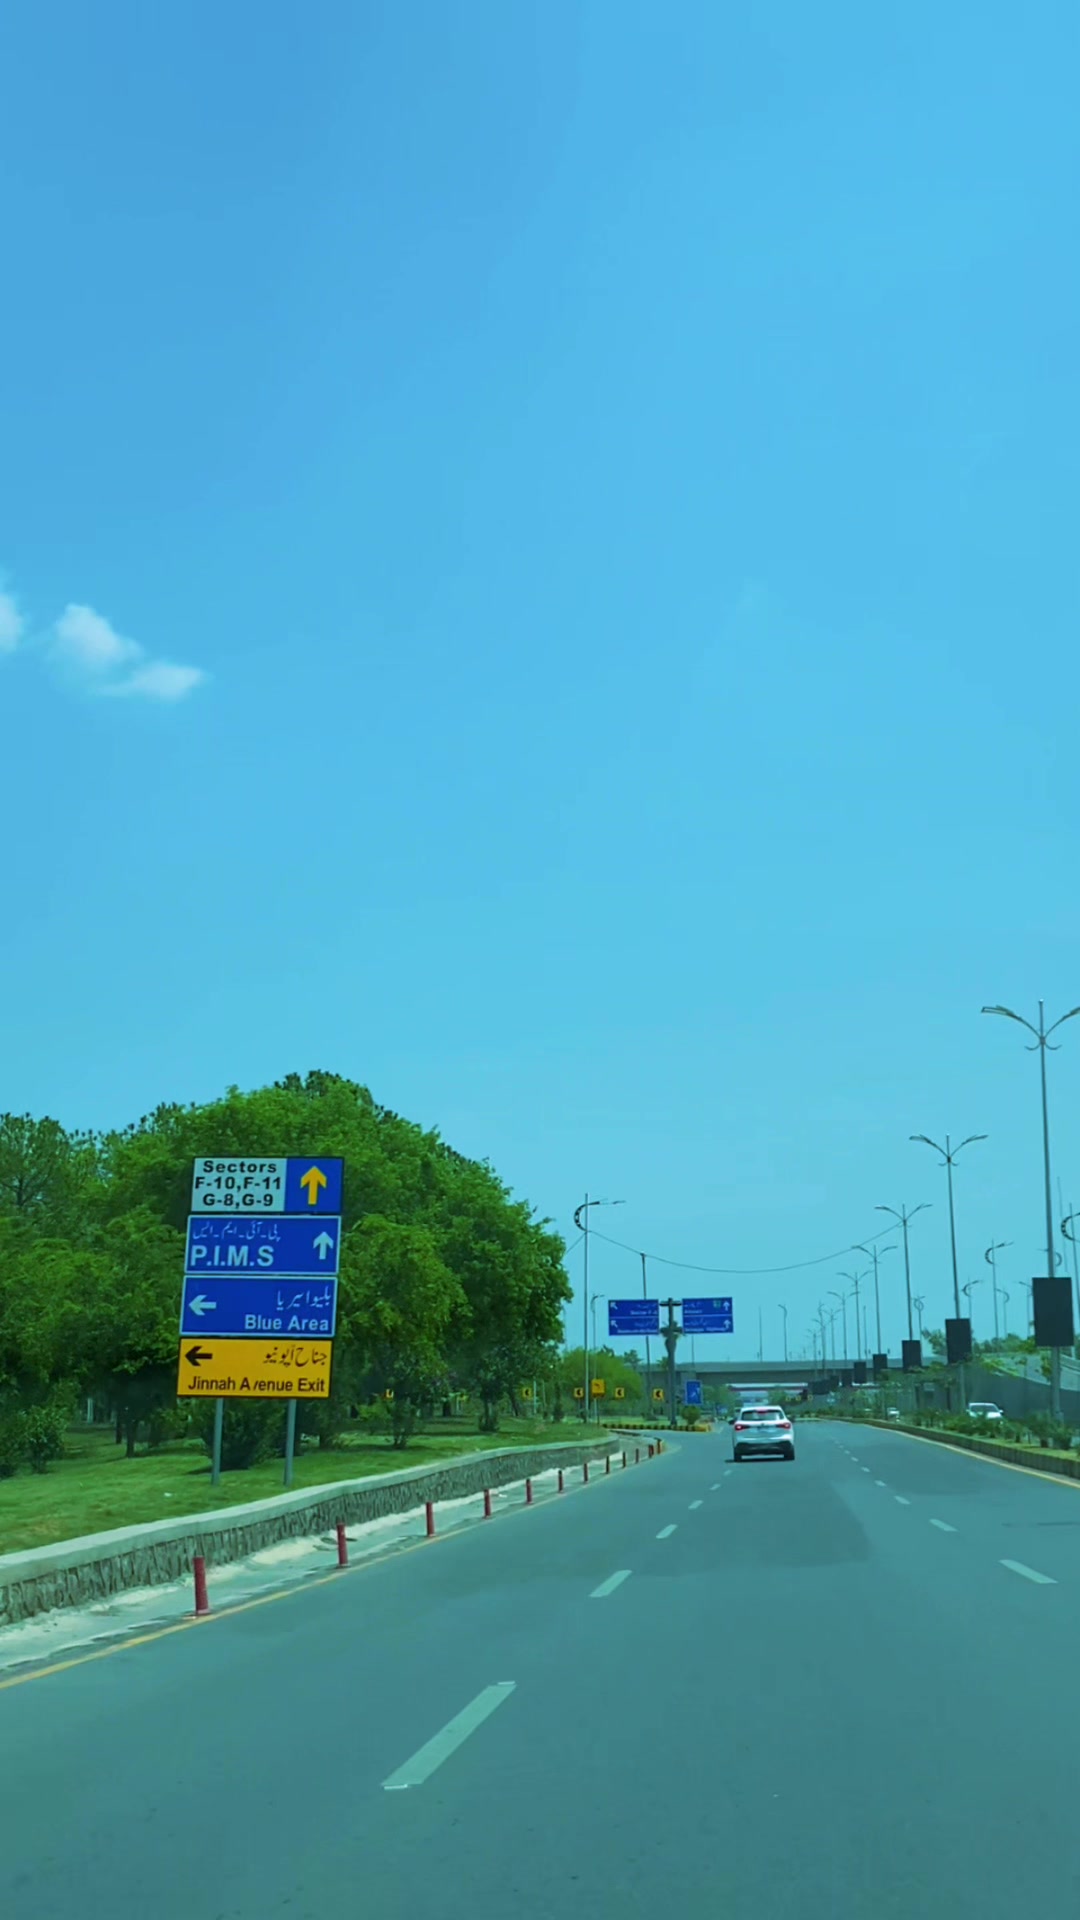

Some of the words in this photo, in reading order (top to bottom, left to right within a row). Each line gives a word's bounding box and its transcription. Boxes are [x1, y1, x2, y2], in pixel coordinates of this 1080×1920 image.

[203, 1160, 277, 1173] Sectors
[190, 1245, 274, 1267] P.I.M.S
[244, 1314, 282, 1330] Blue
[287, 1315, 329, 1331] Area
[188, 1376, 236, 1391] Jinnah
[298, 1378, 325, 1392] Exit
